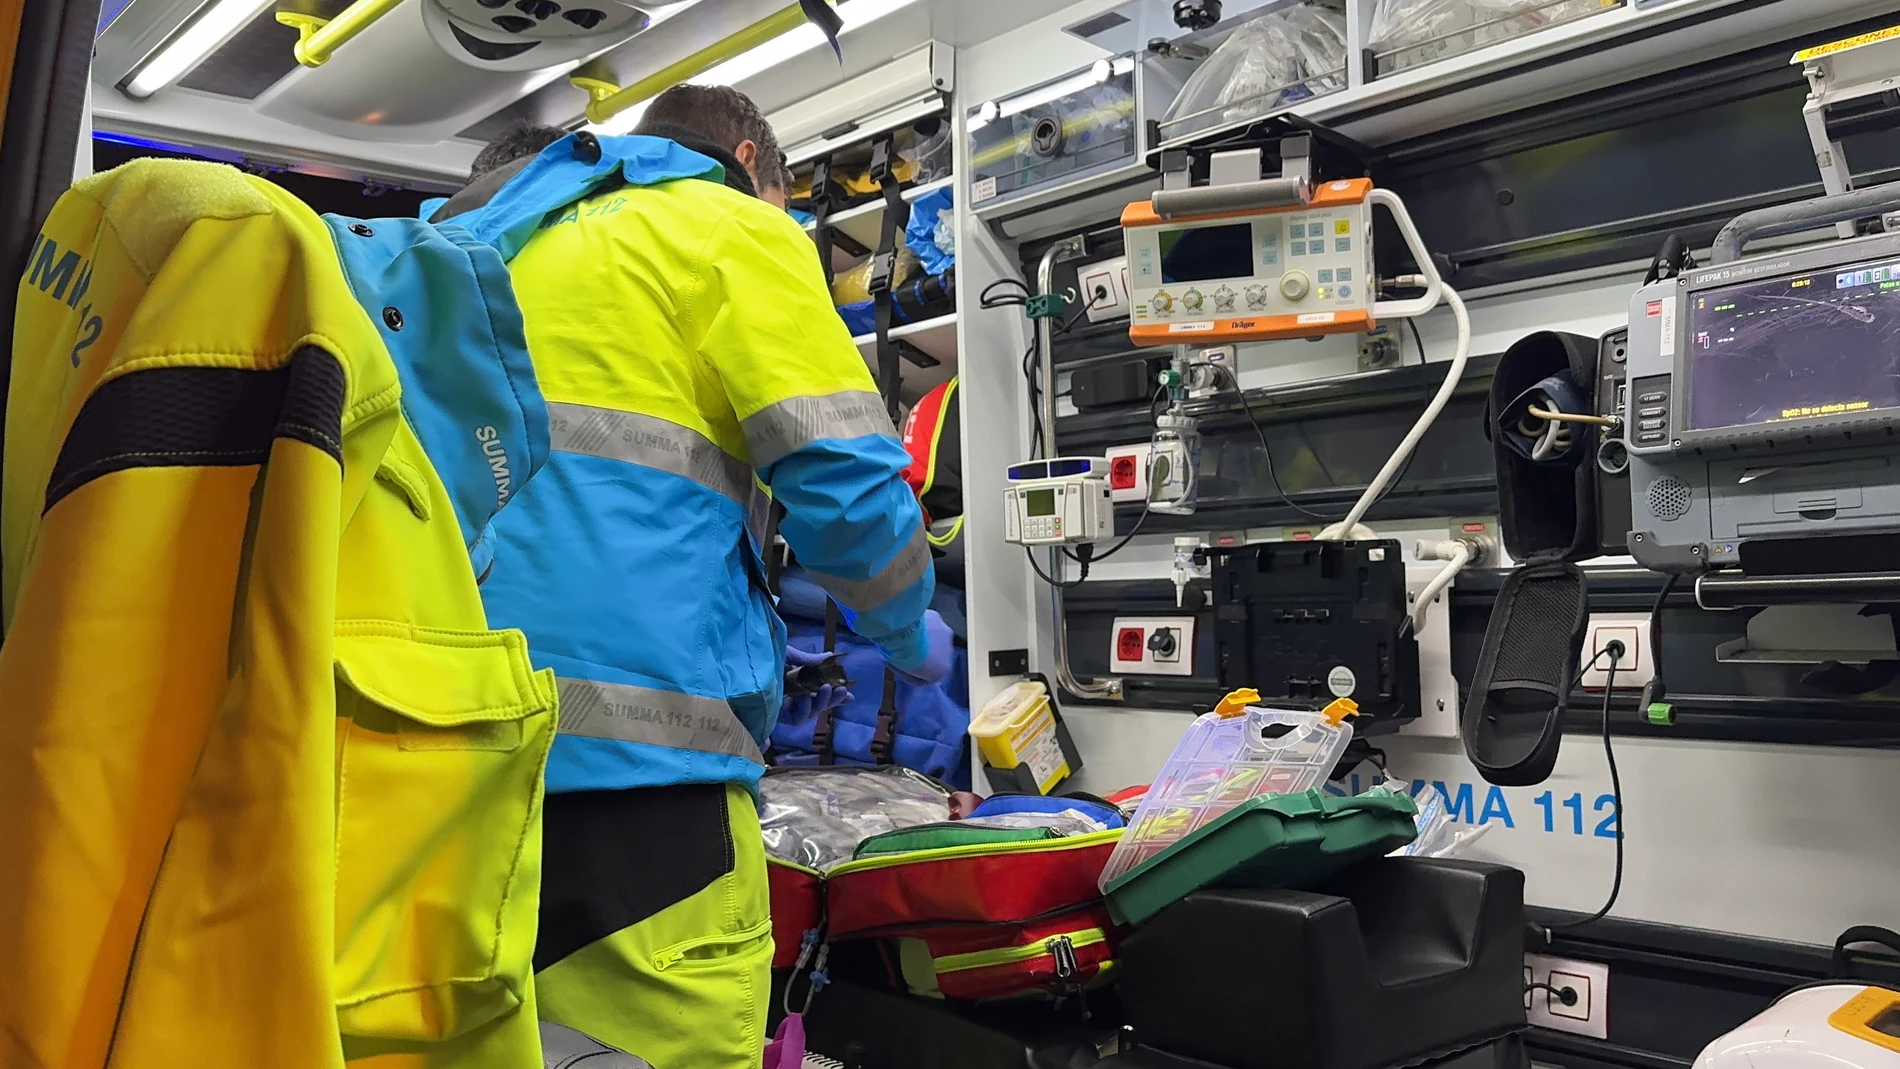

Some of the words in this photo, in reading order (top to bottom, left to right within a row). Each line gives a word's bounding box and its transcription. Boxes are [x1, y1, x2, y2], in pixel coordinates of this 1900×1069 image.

[585, 197, 627, 217] 112
[1696, 270, 1722, 284] LIFEPAK
[1722, 271, 1730, 279] 15
[1231, 320, 1255, 329] Dräger
[1801, 407, 1811, 415] No
[1846, 401, 1869, 410] sensor
[622, 428, 682, 454] SUMMA
[602, 702, 663, 725] SUMMA
[667, 711, 693, 729] 112
[699, 715, 721, 732] 112
[1534, 790, 1625, 840] 112
